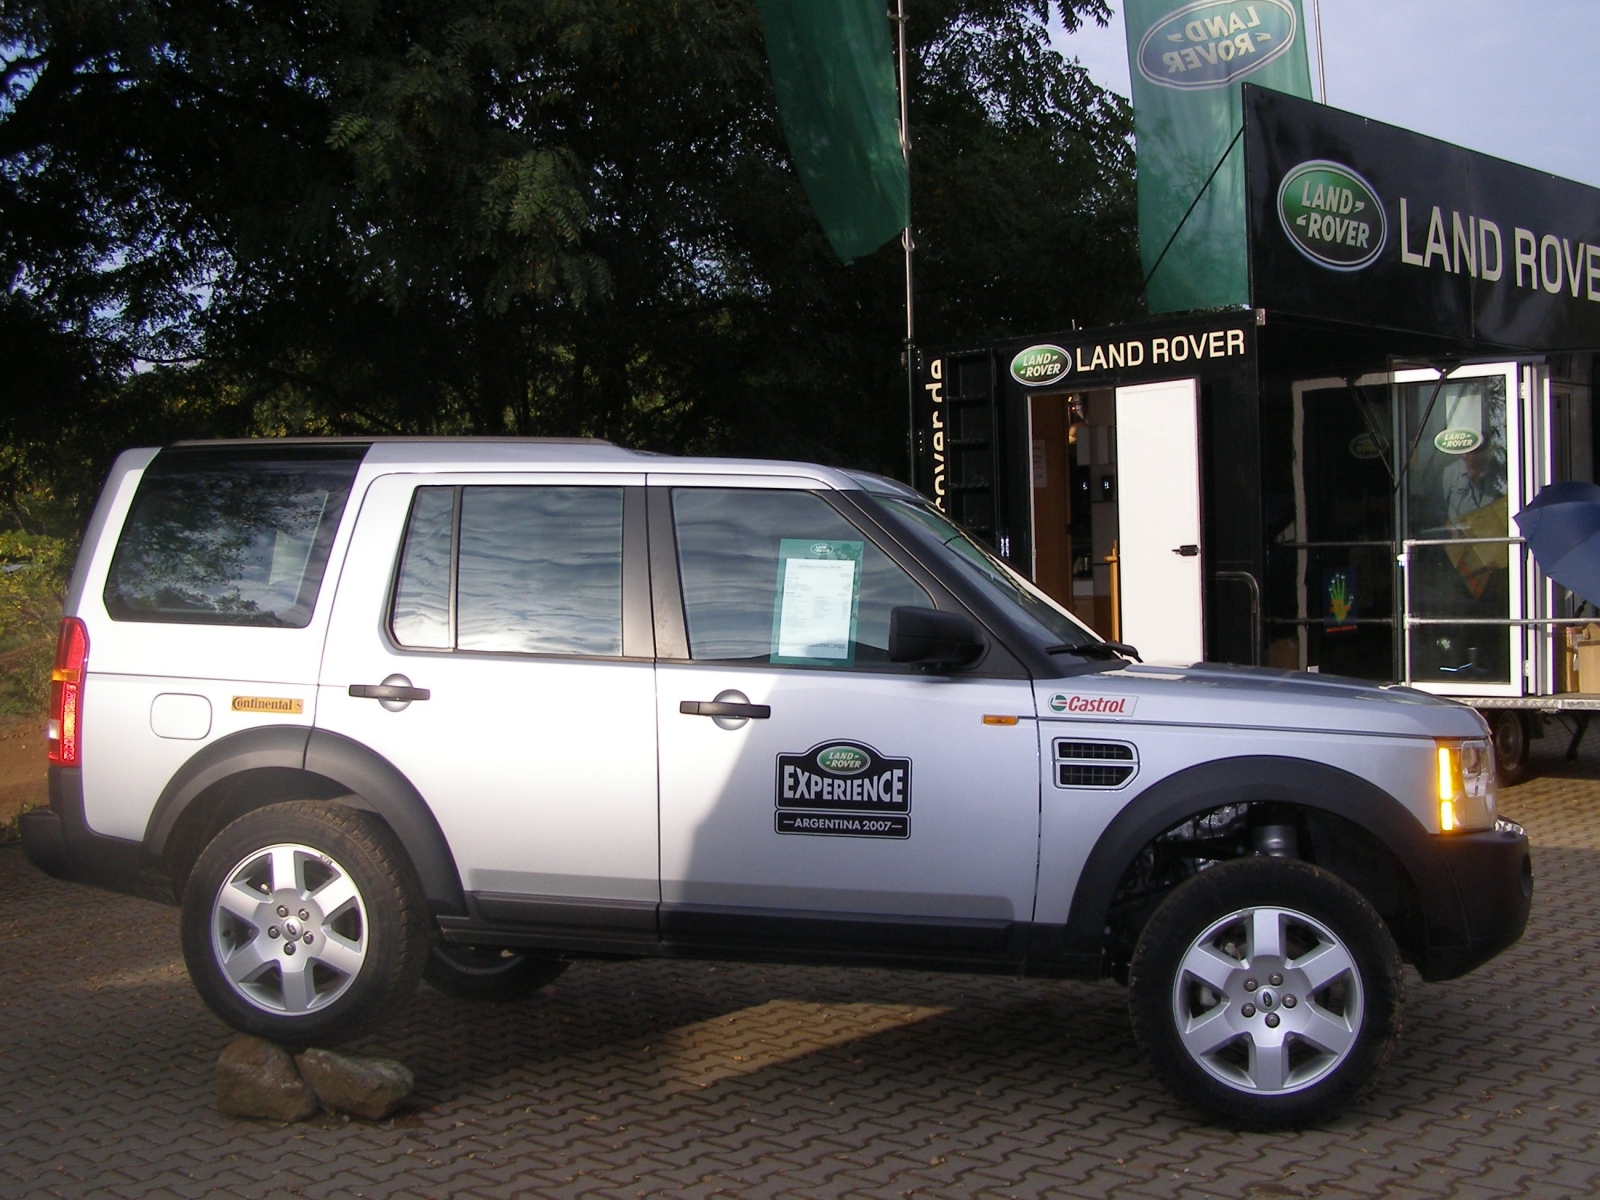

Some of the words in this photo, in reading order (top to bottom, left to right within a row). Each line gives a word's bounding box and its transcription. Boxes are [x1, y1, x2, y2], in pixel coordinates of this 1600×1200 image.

[1301, 180, 1353, 215] LAND
[1307, 212, 1370, 249] ROVER
[1400, 197, 1503, 282] LAND
[1076, 340, 1145, 372] LAND
[1151, 328, 1246, 364] ROVER
[1022, 352, 1052, 367] LAND
[1025, 363, 1061, 378] ROVER
[1444, 433, 1466, 441] LAND
[1446, 439, 1473, 448] ROVER
[232, 696, 293, 711] Continental
[1068, 695, 1126, 714] Castrol
[828, 751, 854, 760] LAND
[830, 759, 862, 769] ROVER
[783, 764, 904, 803] EXPERIENCE
[794, 817, 861, 830] ARGENTINA
[863, 820, 892, 832] 2007
